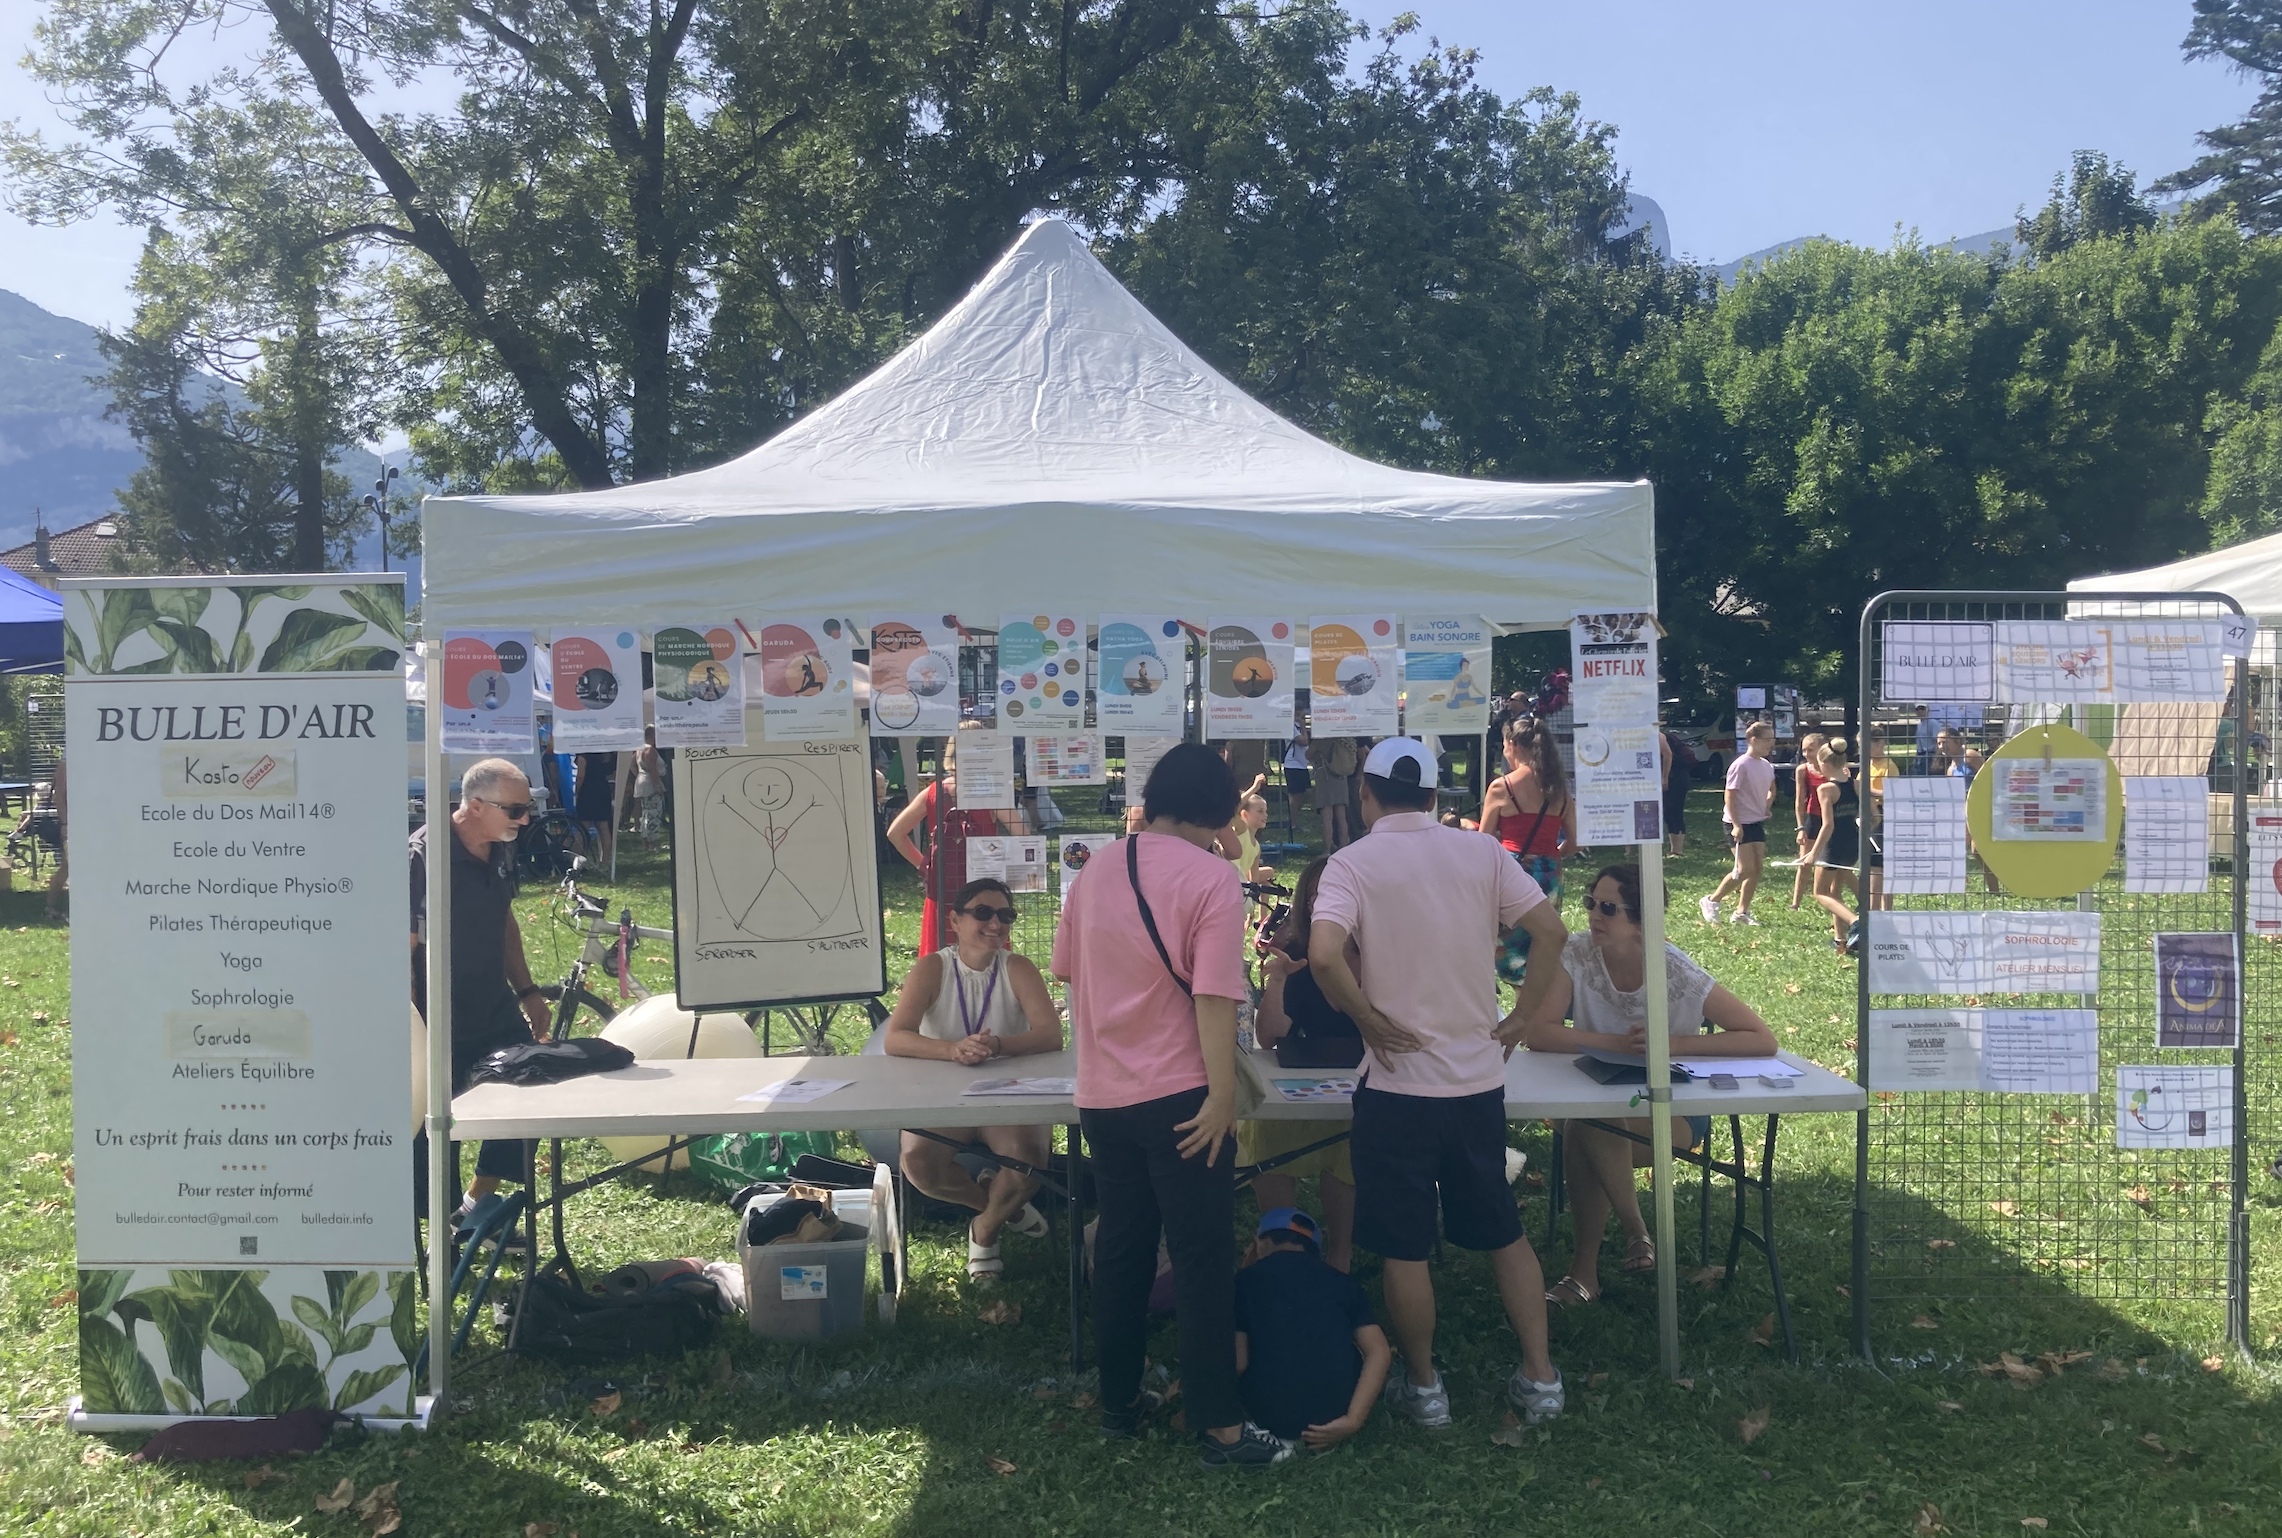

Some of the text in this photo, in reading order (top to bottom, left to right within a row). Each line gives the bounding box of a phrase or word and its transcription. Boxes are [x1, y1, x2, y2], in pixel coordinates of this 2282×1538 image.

[1430, 621, 1460, 629] YOGA
[2228, 627, 2247, 640] 47
[1410, 632, 1480, 641] BAIN SONORE
[1583, 659, 1646, 678] NETFLIX
[1899, 656, 1977, 667] BULLE D'AIR
[96, 704, 376, 742] BULLE D'AIR
[685, 747, 729, 758] BOUGER
[804, 741, 861, 754] RESPIRER
[186, 757, 239, 784] Kosto
[246, 760, 273, 785] nouveau
[141, 804, 186, 821] Ecole
[193, 804, 214, 821] du
[221, 804, 254, 821] Dos
[174, 841, 306, 858] Ecole du Ventre
[125, 877, 353, 898] Marche Nordique Physio®
[149, 915, 332, 934] Pilates Thérapeutique
[1874, 943, 1898, 951] COURS
[2005, 936, 2078, 945] SOPHROLOGIE
[220, 952, 262, 971] Yoga
[1996, 964, 2084, 974] ATELIER MENSUEL
[191, 989, 294, 1009] Sophrologie
[193, 1025, 251, 1046] Garuda
[172, 1058, 315, 1082] Ateliers Équilibre
[95, 1129, 393, 1150] Un esprit frais dans un corps frais
[178, 1182, 313, 1200] Pour rester informé
[116, 1212, 373, 1227] bulledair.contact@gmail.com bulledair.info
